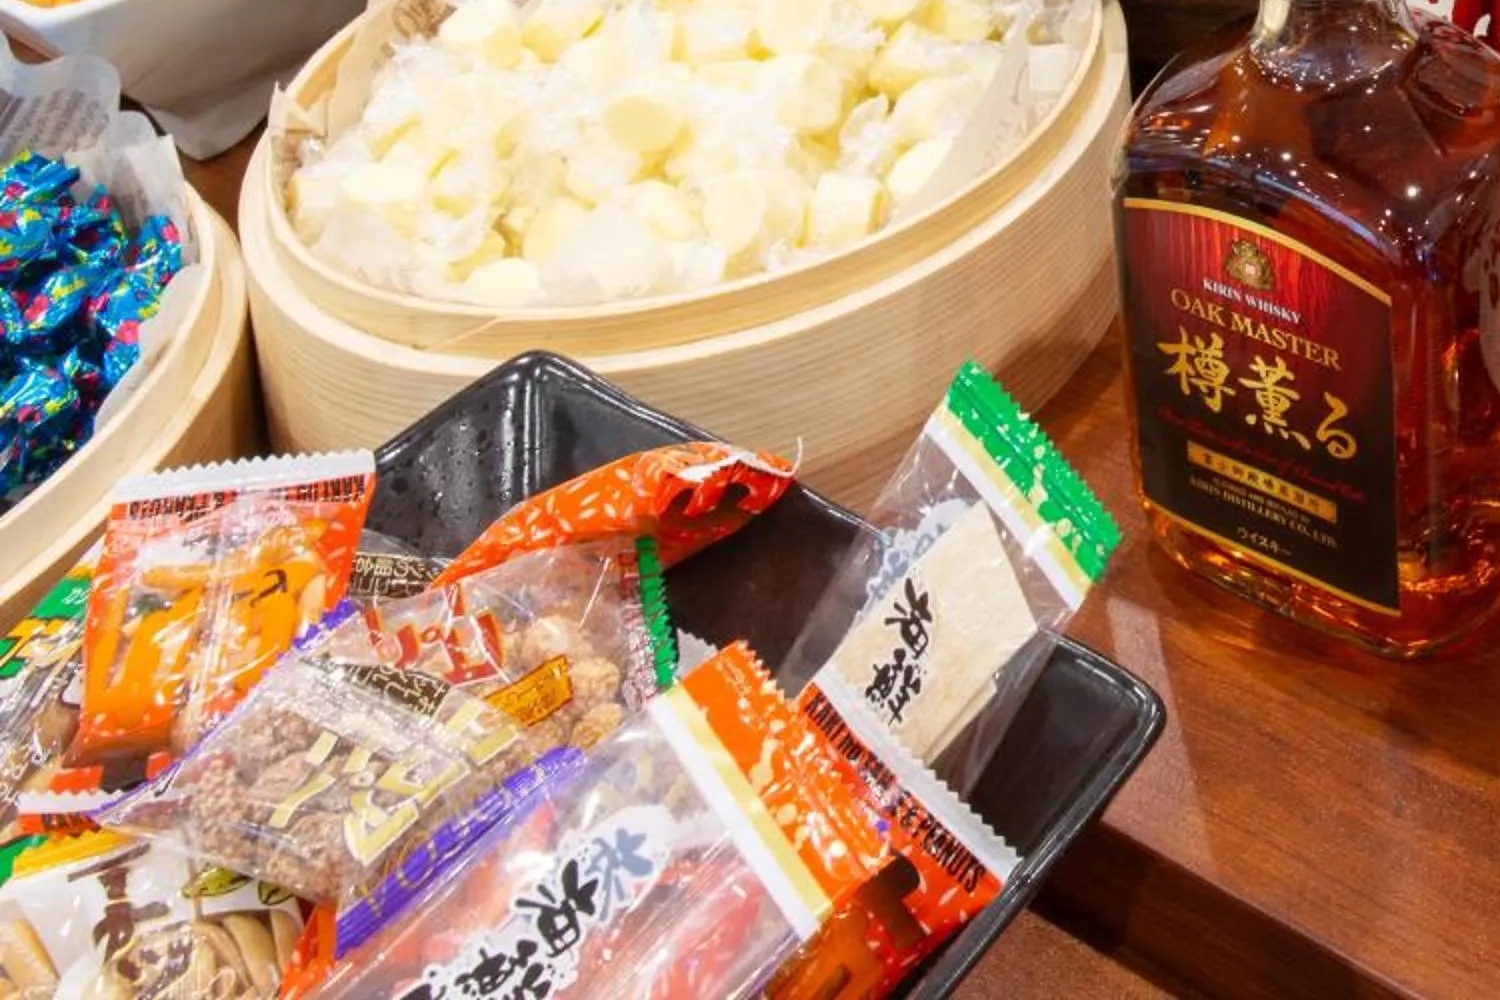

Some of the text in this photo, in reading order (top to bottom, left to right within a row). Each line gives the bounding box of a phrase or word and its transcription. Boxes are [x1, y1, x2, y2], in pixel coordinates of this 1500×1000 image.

[1171, 288, 1342, 372] OAK MASTER
[1244, 293, 1301, 325] WHISKY
[1156, 326, 1358, 461] 樽薫る
